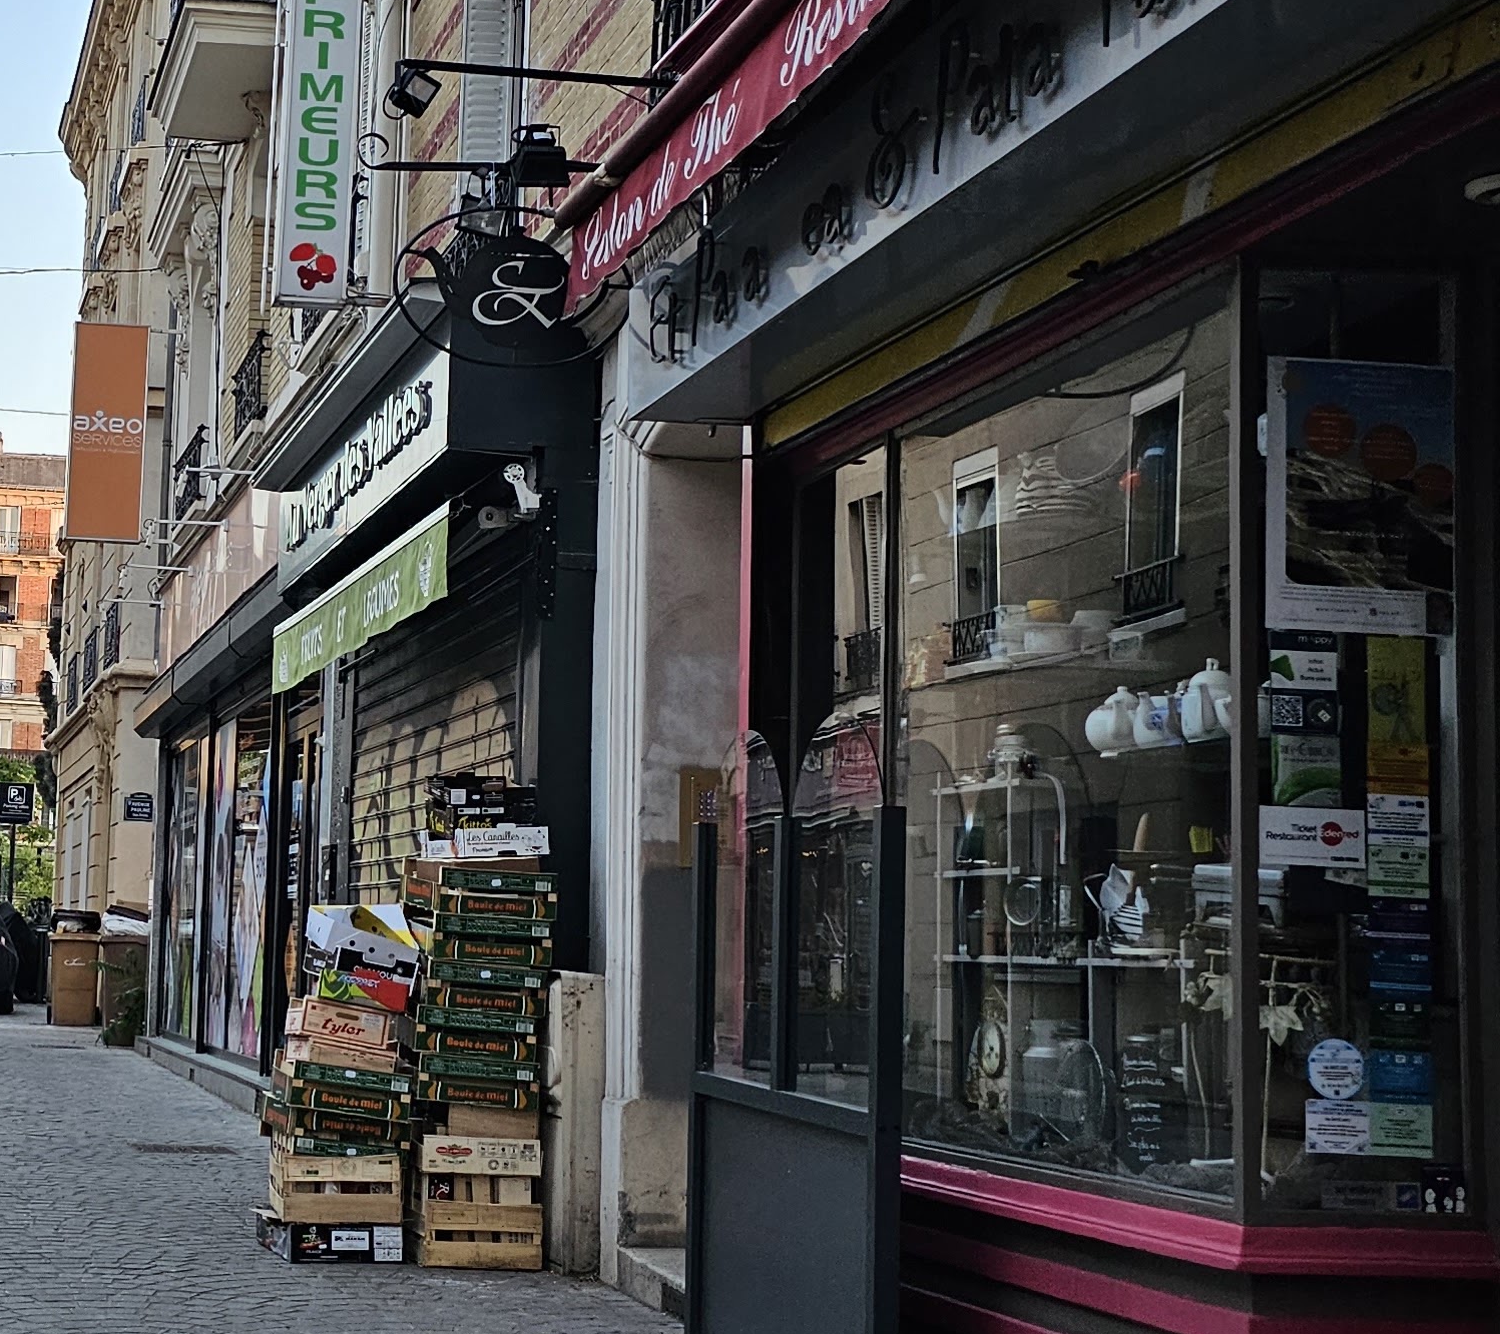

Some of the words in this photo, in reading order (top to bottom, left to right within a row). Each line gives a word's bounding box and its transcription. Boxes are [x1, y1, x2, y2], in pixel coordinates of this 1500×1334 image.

[581, 191, 650, 280] Salon
[650, 140, 681, 216] de
[684, 77, 744, 179] Thé
[73, 410, 143, 435] axeo
[339, 439, 366, 498] des
[10, 788, 19, 799] P
[1290, 822, 1318, 833] Ticket
[466, 831, 482, 842] Les
[482, 829, 520, 842] Canailles
[1265, 830, 1318, 842] Restaurant
[494, 998, 516, 1008] Miel
[321, 1017, 366, 1037] tyler
[446, 1036, 473, 1048] Boule
[485, 1041, 508, 1052] Miel
[321, 1092, 348, 1105] Boule
[360, 1099, 383, 1110] Miel
[447, 1087, 473, 1099] Boule
[486, 1091, 508, 1102] Miel
